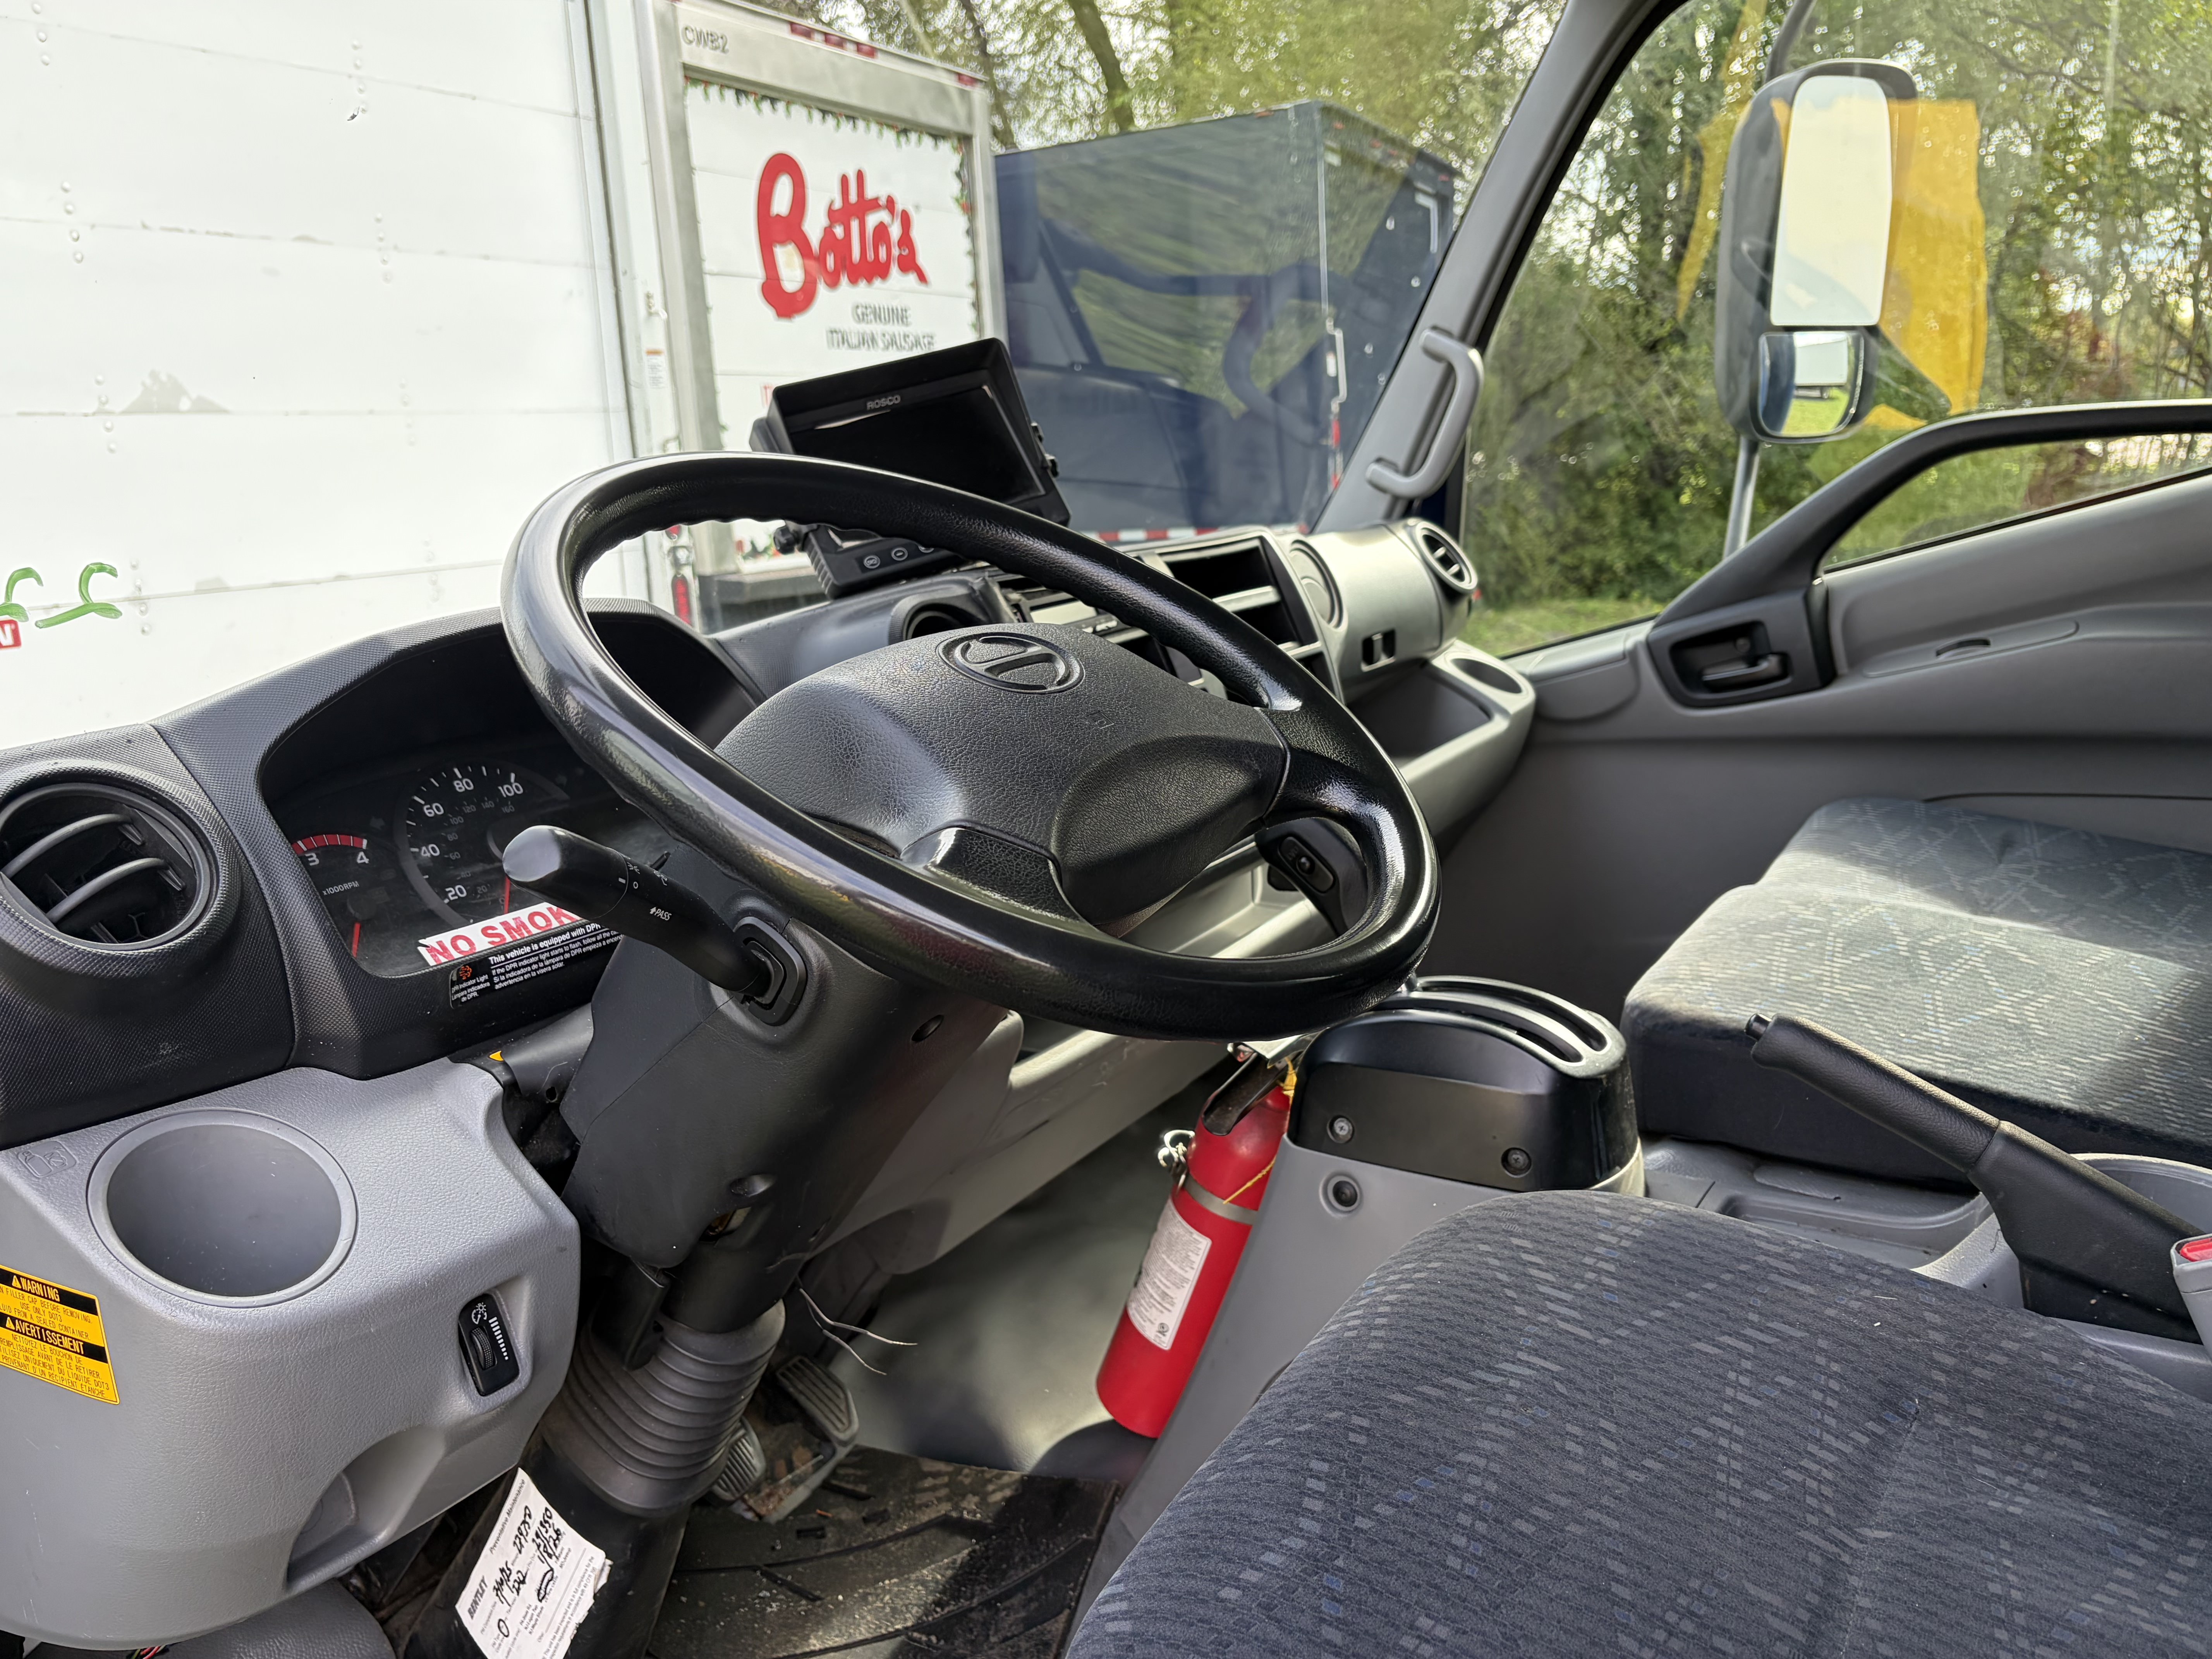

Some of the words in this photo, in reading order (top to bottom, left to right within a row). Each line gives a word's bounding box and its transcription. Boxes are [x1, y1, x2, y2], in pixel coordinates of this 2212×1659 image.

[682, 25, 729, 55] CWB2
[758, 153, 928, 318] Botto's
[852, 302, 912, 326] GENUINE
[826, 328, 878, 351] ITALIAN
[880, 331, 935, 352] SAUSAGE
[867, 395, 901, 410] ROSCO
[453, 778, 474, 792] 80
[498, 782, 523, 798] 100
[423, 803, 444, 817] 60
[463, 804, 476, 813] 120
[481, 800, 495, 809] 140
[450, 816, 464, 825] 100
[447, 833, 458, 841] 80
[304, 853, 319, 866] 3
[356, 851, 369, 864] 4
[421, 844, 440, 857] 40
[323, 881, 359, 895] x1000RPM
[445, 885, 467, 900] 20
[477, 885, 488, 893] 20
[654, 908, 672, 921] PASS
[426, 935, 477, 964] NO
[481, 907, 579, 946] SMOK
[489, 955, 505, 964] This
[506, 946, 531, 959] vehicle
[539, 931, 570, 947] equipped
[571, 927, 586, 938] with
[586, 923, 601, 933] DPR
[505, 962, 518, 971] DPR
[519, 956, 539, 967] indicator
[539, 951, 550, 960] light
[550, 947, 563, 956] starts
[569, 941, 583, 950] flash,
[582, 936, 596, 945] follow
[506, 967, 531, 979] indicadora
[570, 948, 582, 957] DPR
[582, 942, 602, 953] empieza
[606, 934, 624, 945] encend
[459, 979, 476, 989] Indicator
[476, 974, 488, 982] Light
[495, 976, 524, 990] advertencia
[537, 966, 551, 975] visera
[551, 962, 565, 970] solar.
[467, 982, 490, 993] indicadora
[467, 991, 479, 1000] DPR.
[20, 1277, 60, 1302] WARNING
[6, 1288, 26, 1301] FILLER
[28, 1296, 38, 1305] CAP
[40, 1300, 61, 1314] BEFORE
[63, 1307, 93, 1324] REMOVING.
[20, 1302, 31, 1312] USE
[33, 1306, 45, 1317] ONLY
[49, 1311, 62, 1322] DOT3
[0, 1304, 12, 1314] LUID
[14, 1308, 27, 1319] FROM
[37, 1315, 56, 1329] SEALED
[59, 1324, 91, 1340] CONTAINER.
[15, 1319, 84, 1355] AVERTISSEMENT
[12, 1333, 38, 1349] NETTOYEZ
[40, 1343, 46, 1352] LE
[50, 1347, 73, 1361] BOUCHON
[75, 1356, 83, 1365] DE
[0, 1338, 34, 1356] REMPLISSAGE
[38, 1351, 53, 1363] AVANT
[56, 1357, 64, 1367] DE
[65, 1360, 73, 1370] LE
[76, 1364, 102, 1380] RETIRER.
[0, 1345, 21, 1360] TILISEZ
[23, 1355, 54, 1372] UNIQUEMENT
[58, 1367, 65, 1376] DU
[67, 1370, 91, 1385] LIQUIDE
[94, 1380, 109, 1391] DOT3
[2, 1355, 29, 1371] PROVENANT
[489, 1516, 509, 1554] Preventative
[505, 1479, 526, 1518] Maintenance
[467, 1575, 488, 1620] BENTLEY
